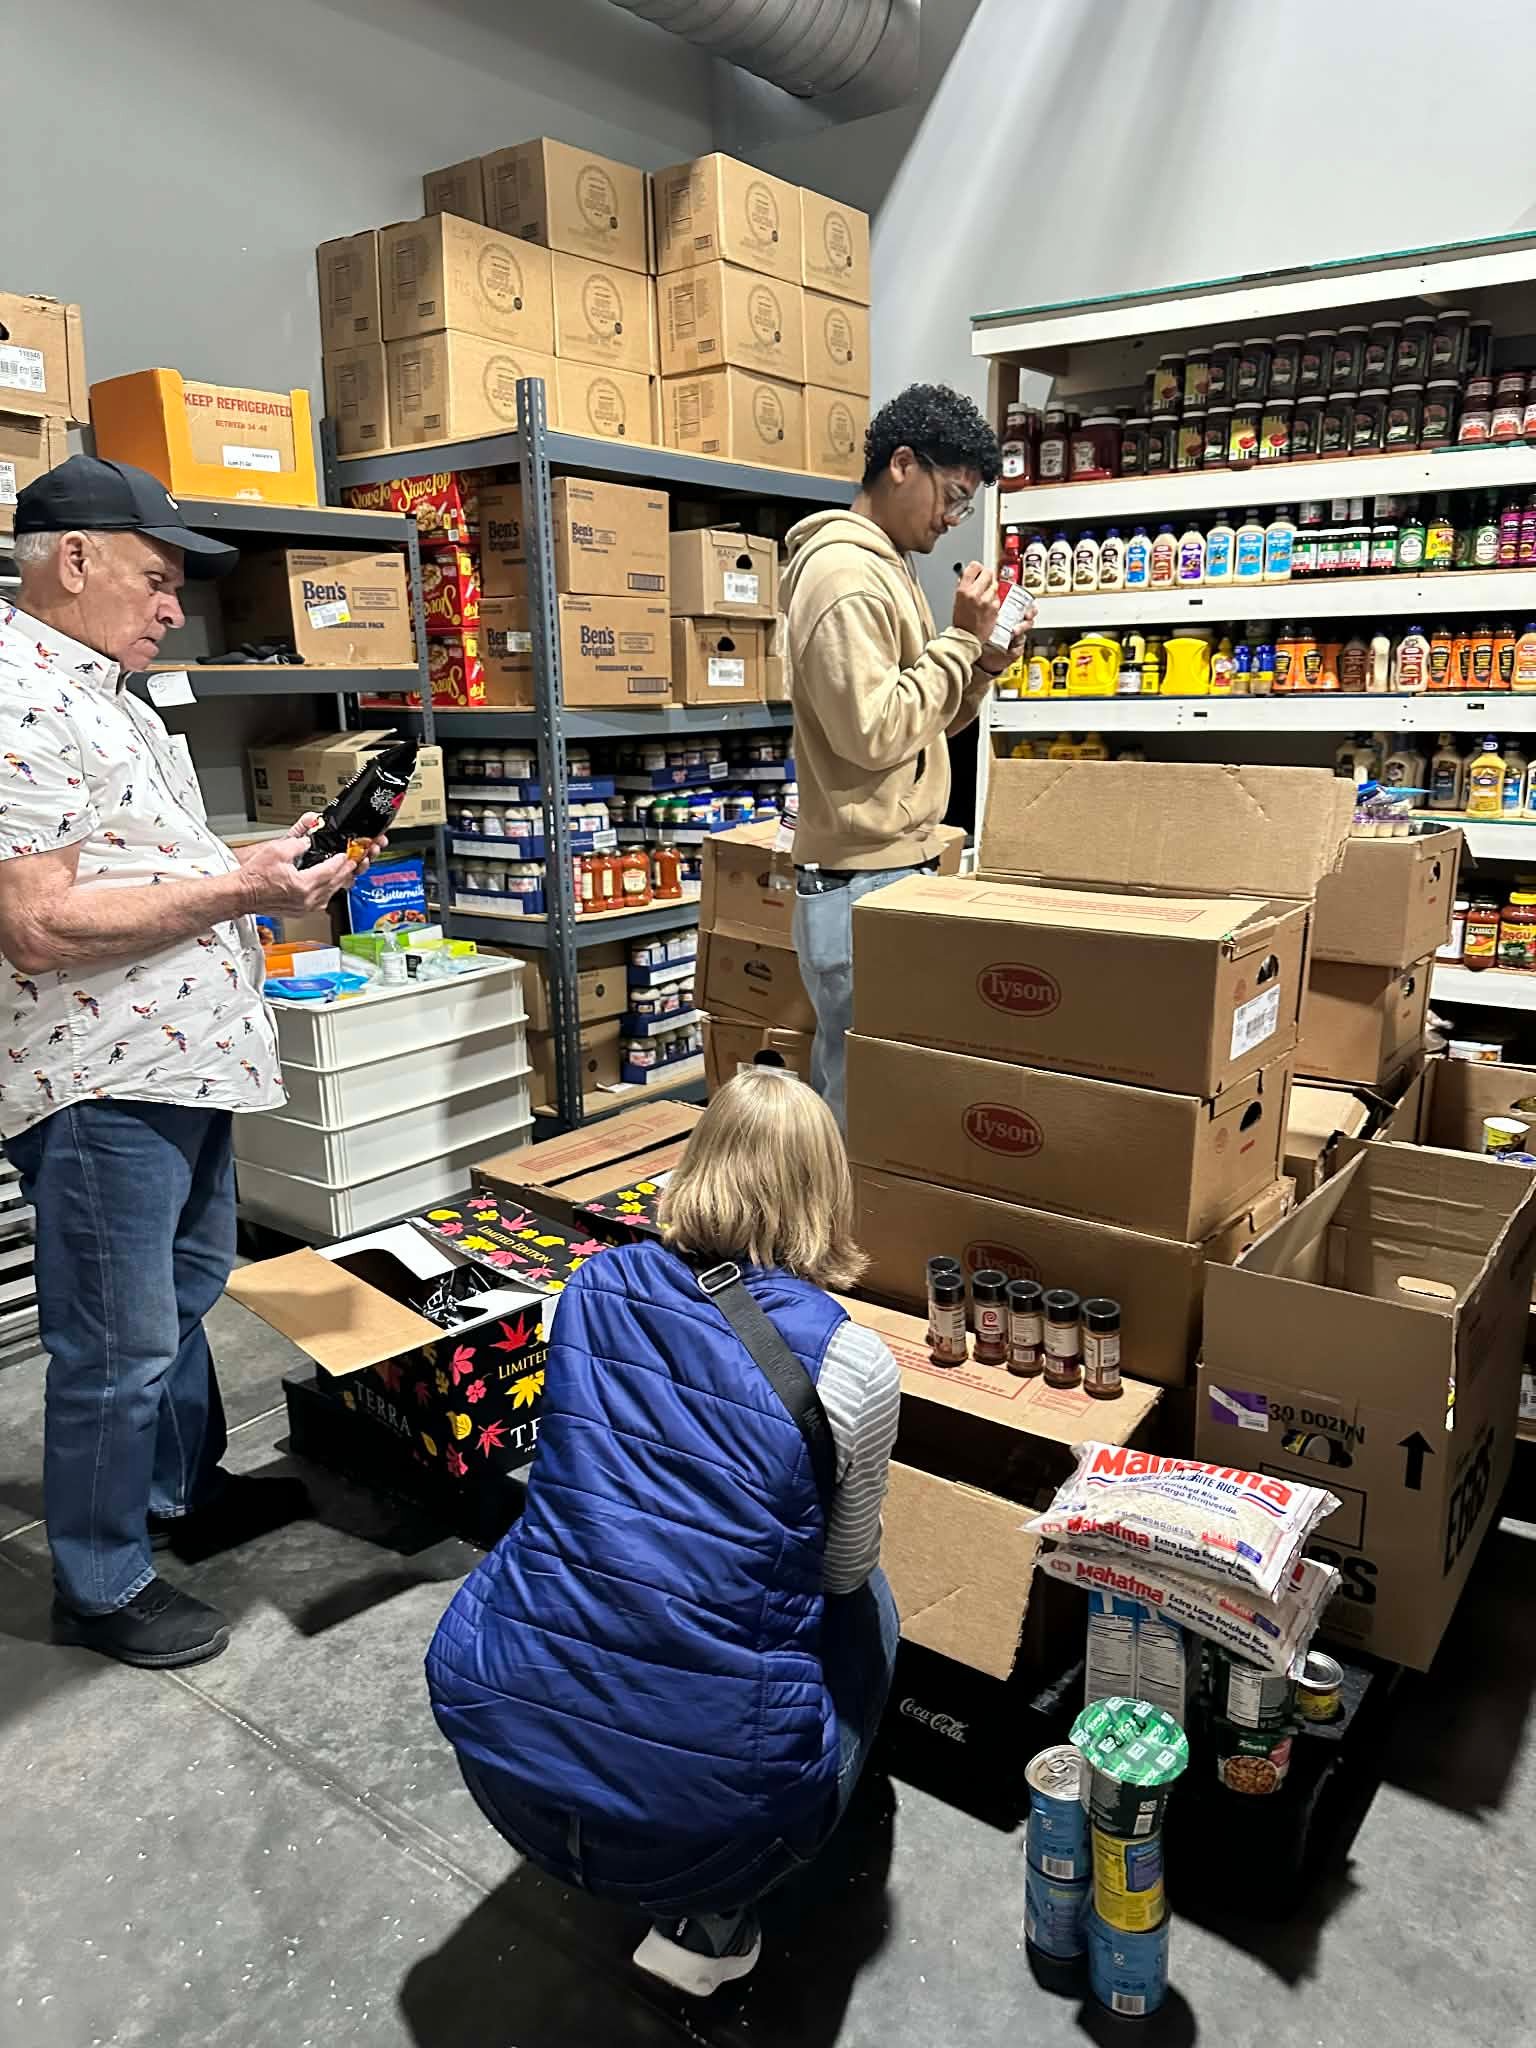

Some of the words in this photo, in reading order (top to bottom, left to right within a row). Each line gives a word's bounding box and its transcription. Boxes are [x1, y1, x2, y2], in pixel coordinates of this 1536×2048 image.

[184, 393, 213, 407] KEEP
[216, 396, 292, 417] REFRIGERATED
[571, 522, 593, 536] Ben's
[302, 580, 347, 600] Ben's
[580, 624, 616, 645] Ben's
[581, 645, 616, 660] Original
[984, 970, 1053, 1003] Tyson
[968, 1109, 1035, 1145] Tyson
[478, 1225, 515, 1246] LIMITED
[512, 1242, 554, 1264] EDITION
[353, 1380, 412, 1437] TERRA
[1269, 1403, 1294, 1422] 30
[1215, 1478, 1241, 1497] RICE
[1067, 1516, 1149, 1548] Mahatma
[1076, 1560, 1164, 1606] Mahatma
[1168, 1593, 1192, 1609] Extra
[1193, 1604, 1215, 1621] Long
